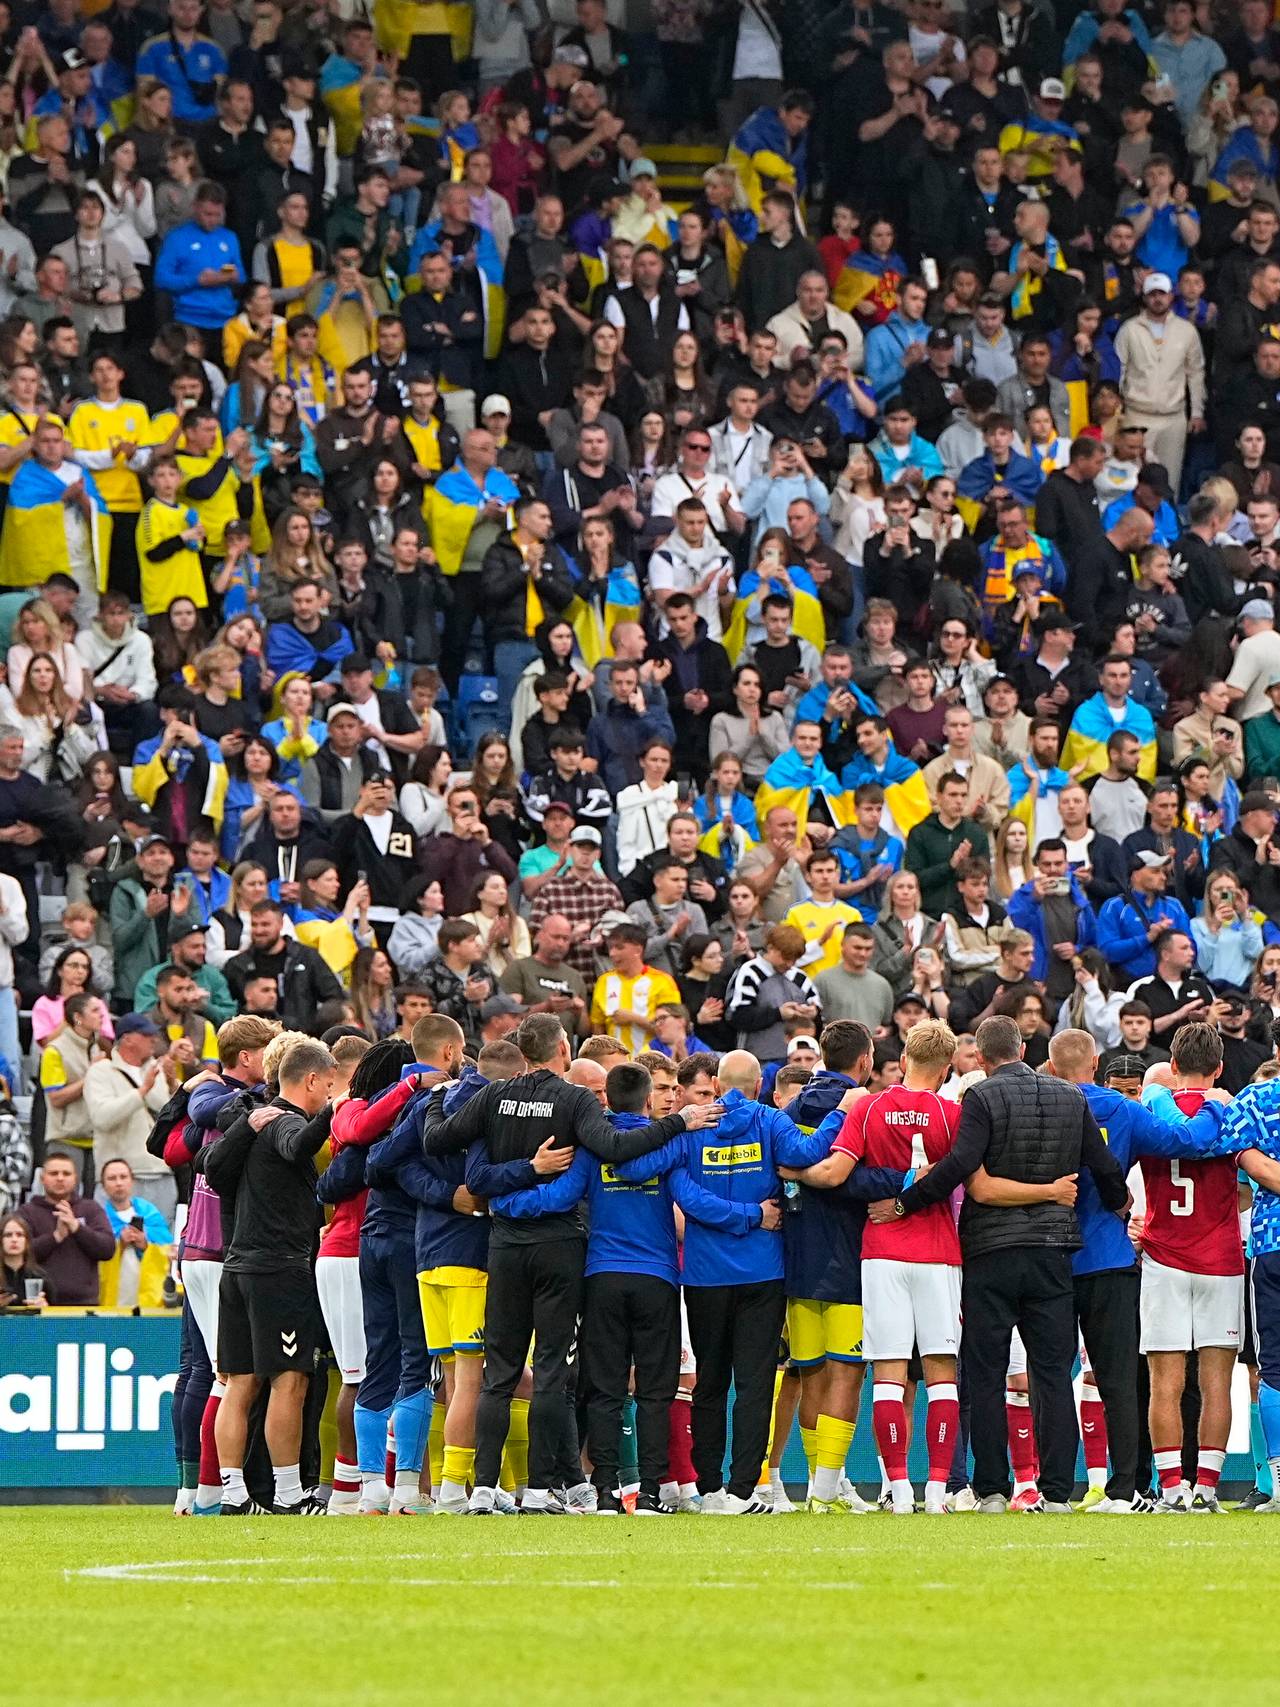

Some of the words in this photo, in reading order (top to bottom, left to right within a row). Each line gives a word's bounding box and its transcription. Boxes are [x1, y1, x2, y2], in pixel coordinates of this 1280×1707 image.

[389, 832, 413, 858] 21
[498, 1099, 518, 1116] FOR
[884, 1110, 930, 1127] HØGSBRG
[1170, 1158, 1194, 1216] 5
